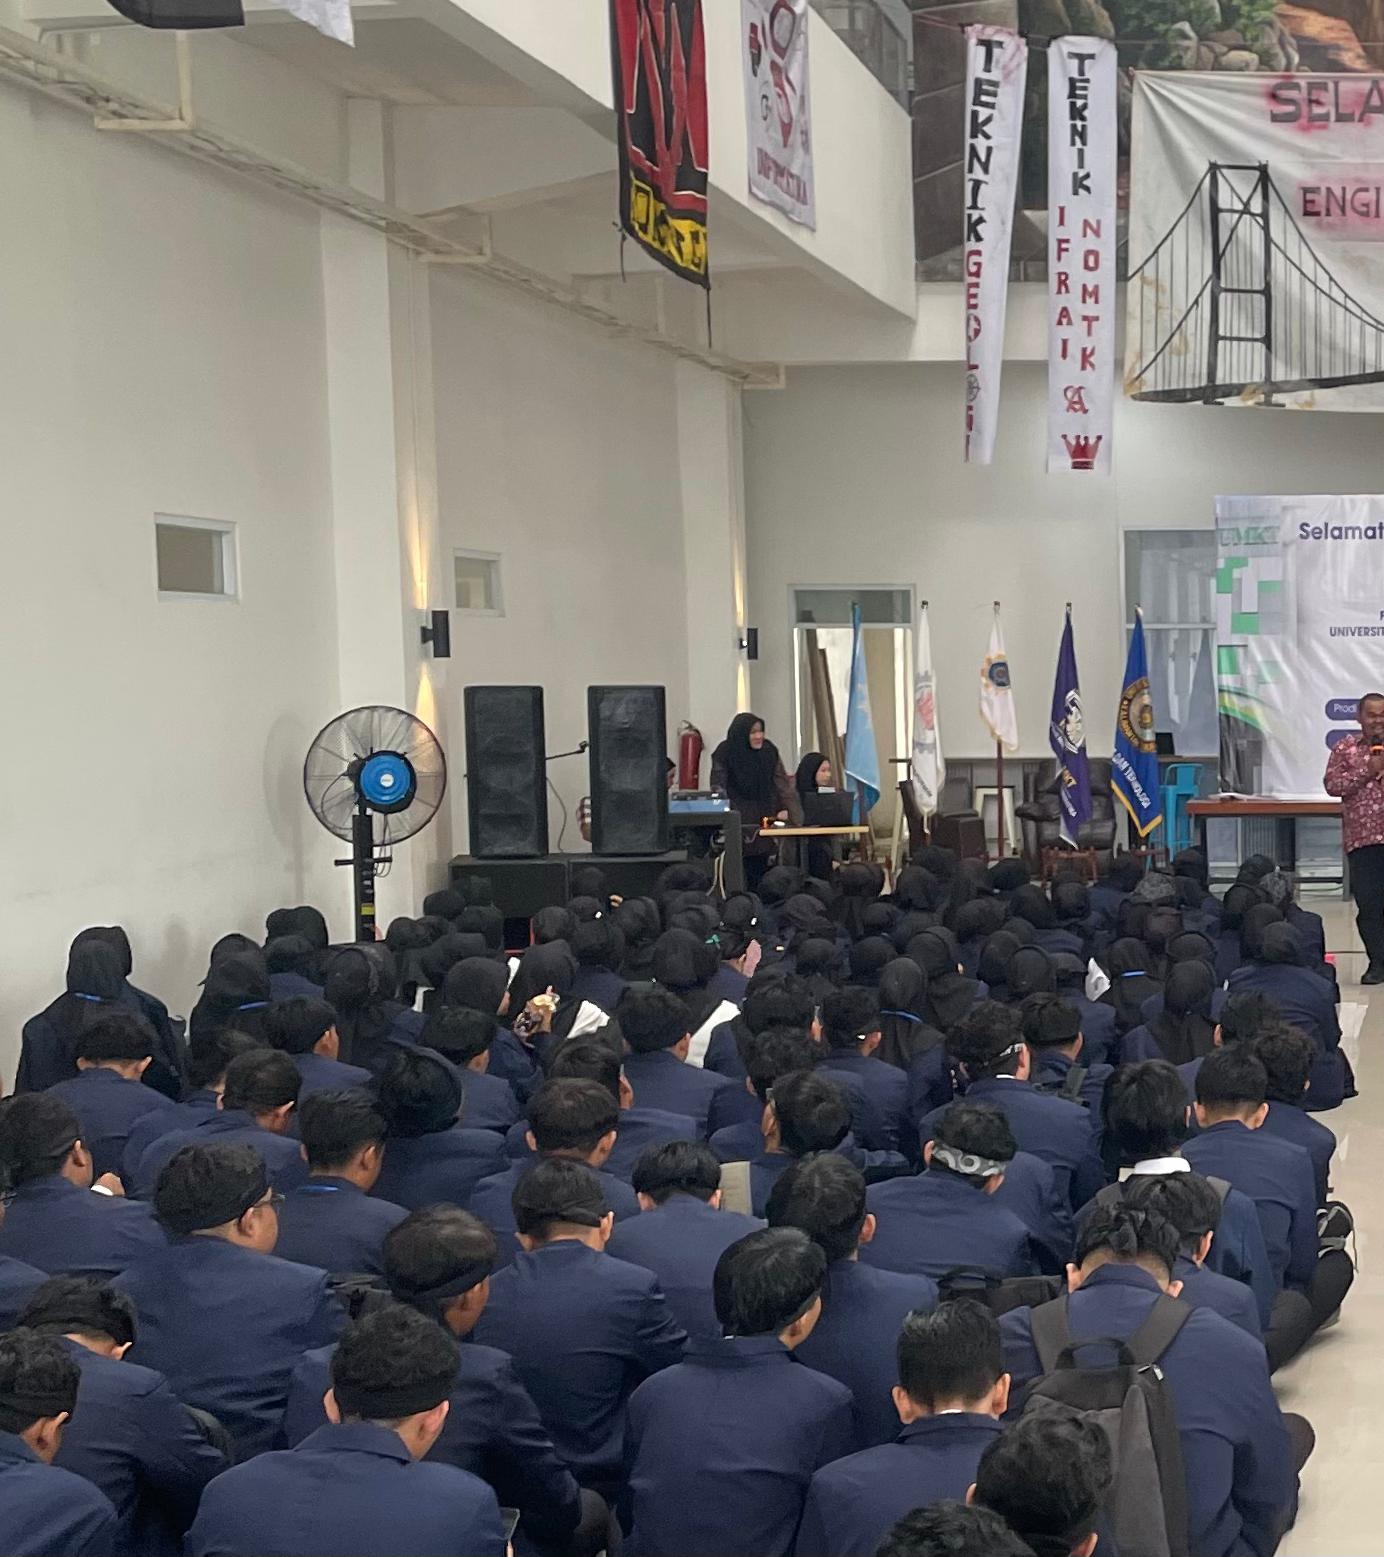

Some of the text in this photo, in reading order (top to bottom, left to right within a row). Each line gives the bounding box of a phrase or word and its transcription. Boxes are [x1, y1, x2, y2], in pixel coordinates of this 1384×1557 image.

[966, 39, 1004, 243] TEKNIK
[1067, 52, 1096, 196] TEKNIK
[1299, 521, 1384, 541] Selamat
